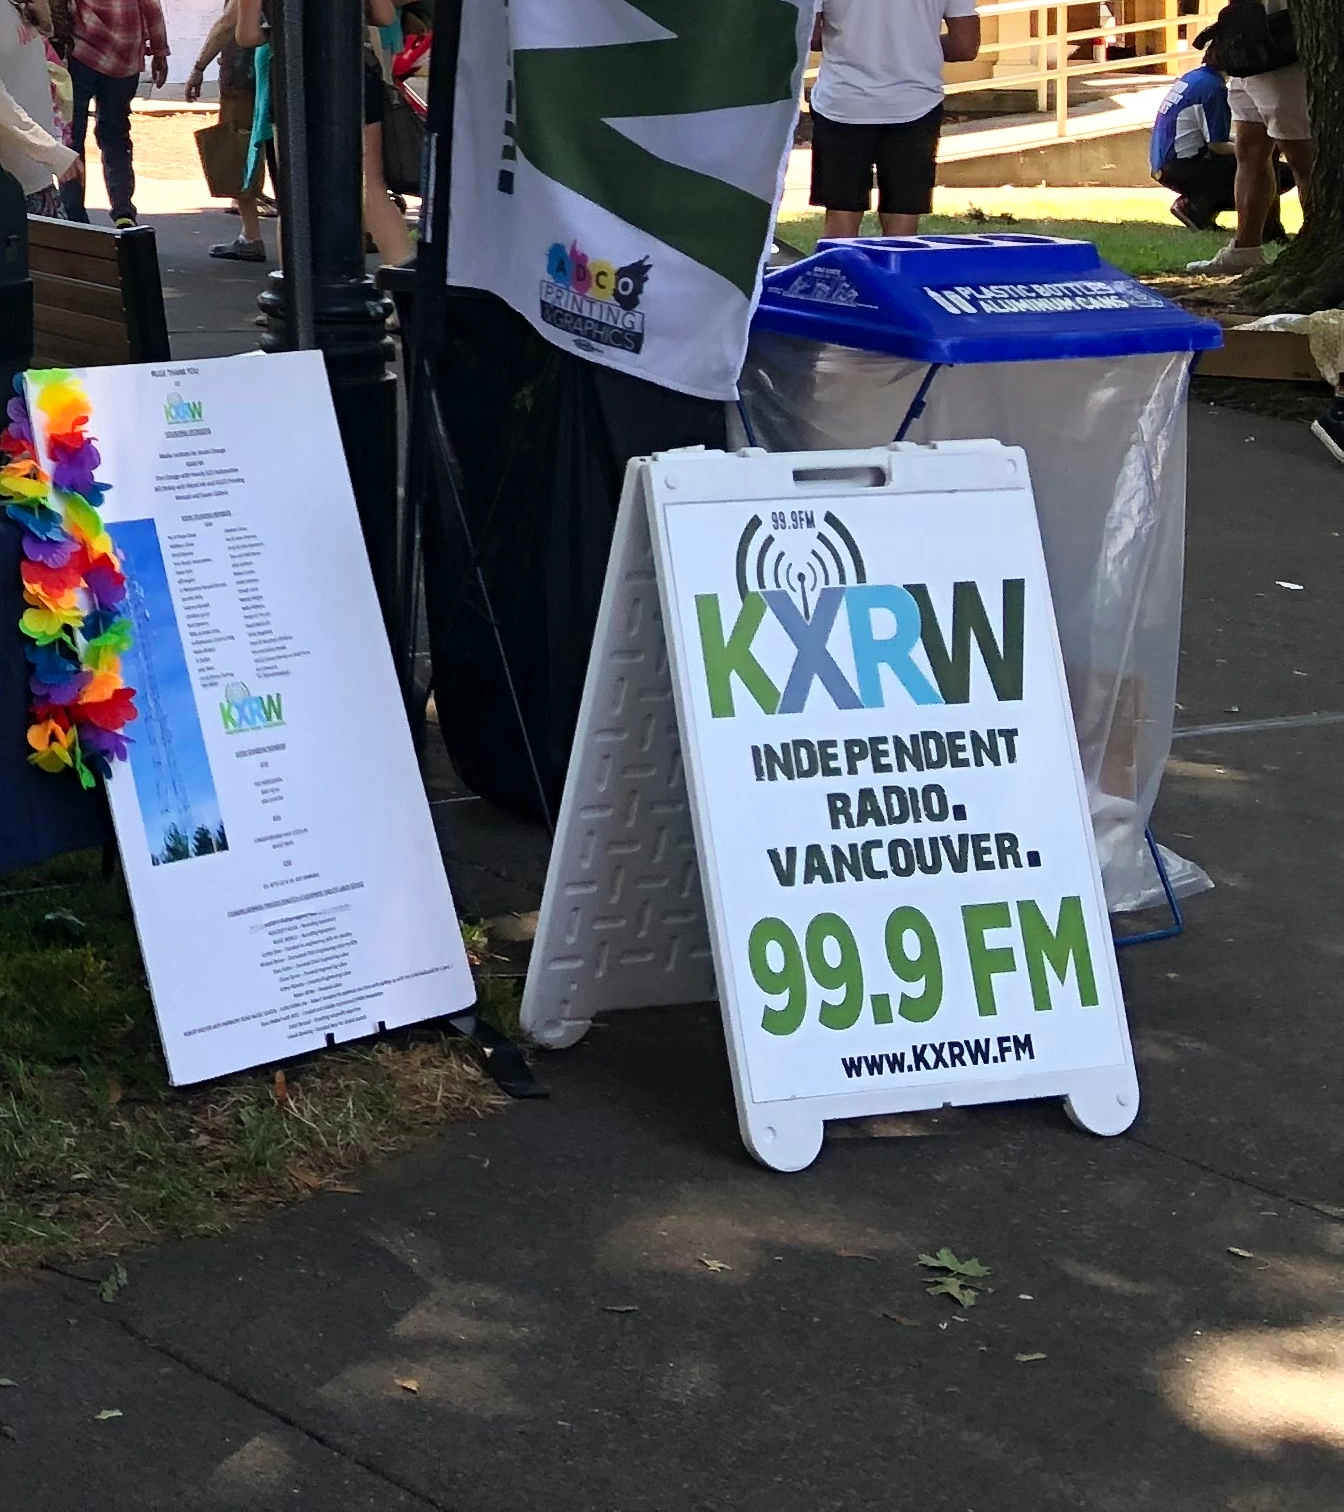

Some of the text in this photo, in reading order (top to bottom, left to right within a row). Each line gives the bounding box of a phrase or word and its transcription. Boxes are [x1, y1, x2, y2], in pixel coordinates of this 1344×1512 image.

[544, 287, 637, 330] PRINTING
[955, 284, 1029, 299] PLASTIC
[1030, 280, 1116, 297] BOTTLES
[978, 295, 1130, 314] ALUMINUM CANS
[771, 509, 816, 532] 99.9FM
[694, 578, 1026, 719] KXRW
[220, 693, 282, 730] KXRW
[751, 728, 1019, 782] INDEPENDENT
[827, 783, 968, 831] RADIO.
[767, 832, 1042, 888] VANCOUVER.
[748, 895, 1100, 1037] 99.9 FM
